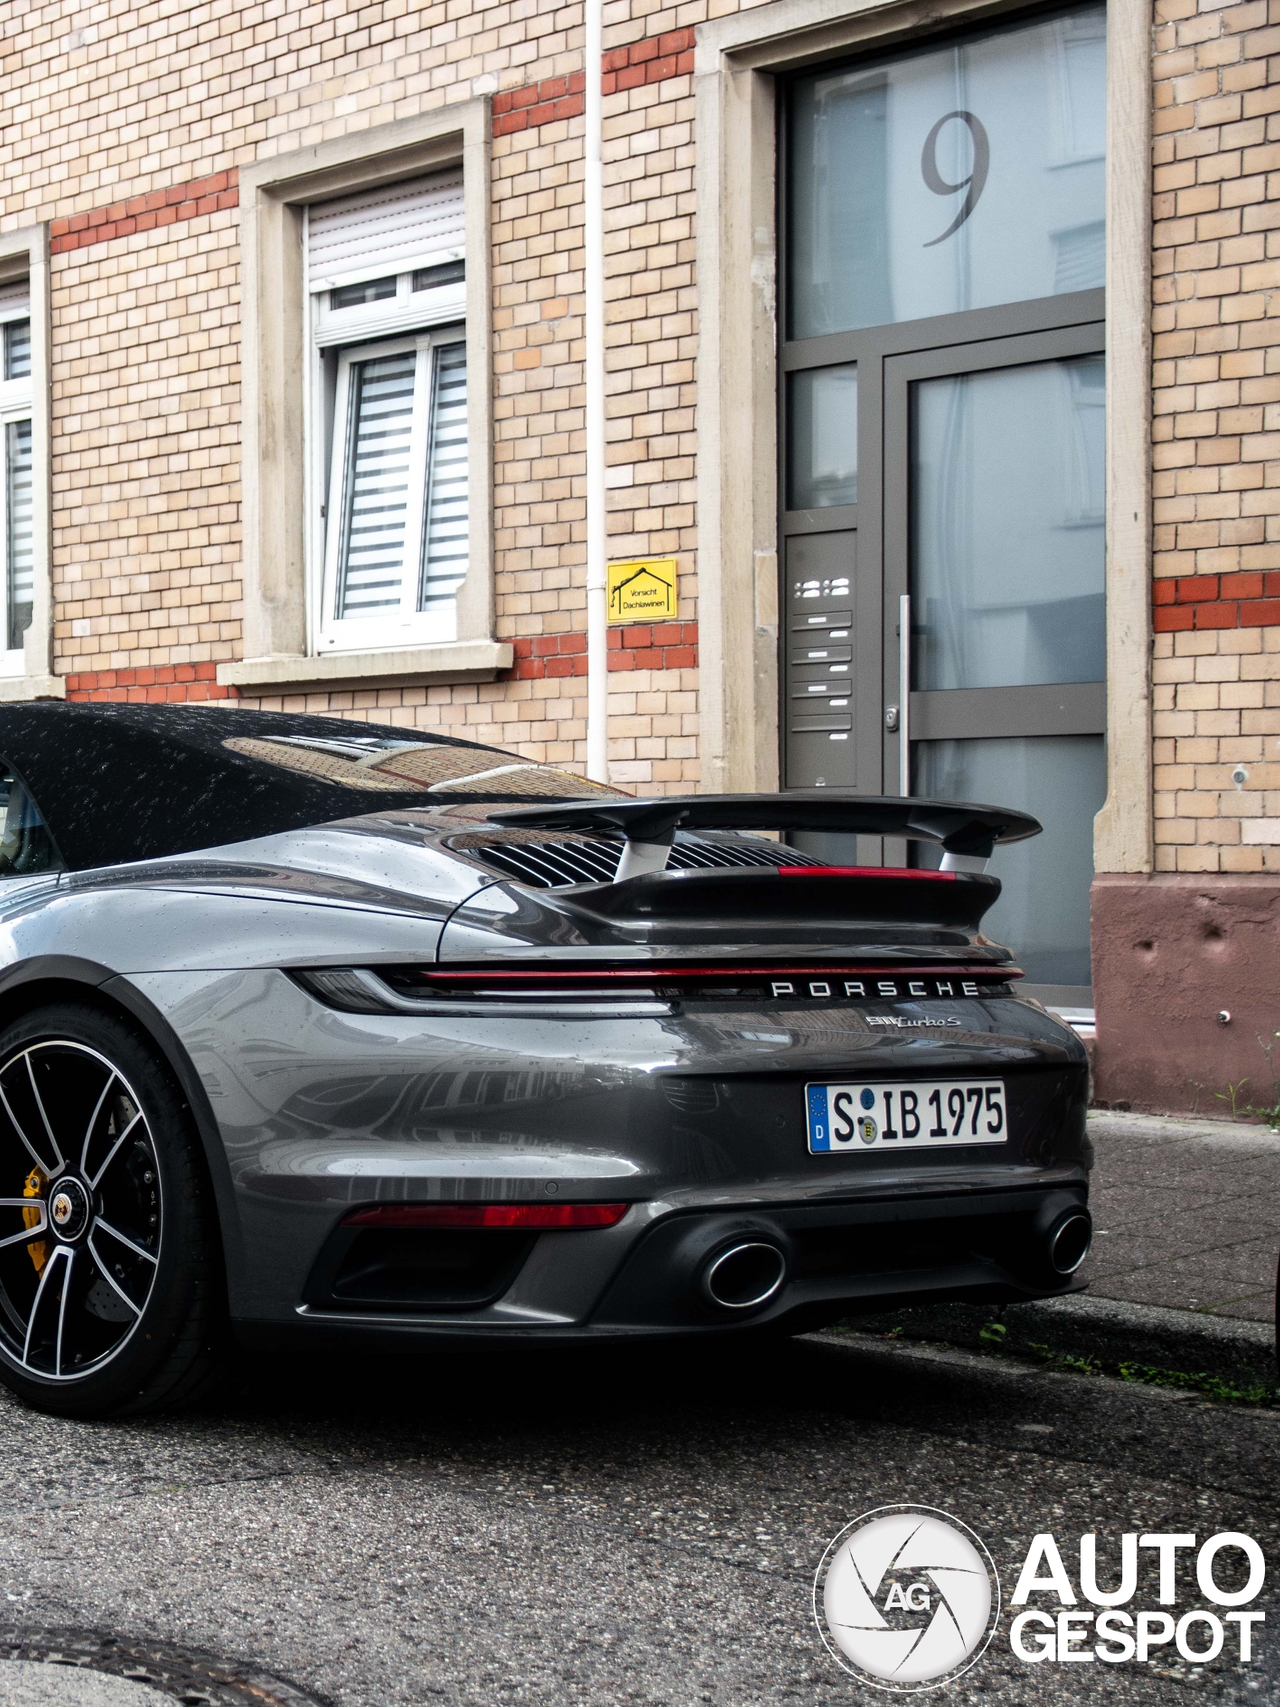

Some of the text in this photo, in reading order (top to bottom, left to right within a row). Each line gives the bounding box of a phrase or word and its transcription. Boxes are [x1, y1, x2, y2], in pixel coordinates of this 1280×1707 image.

[921, 110, 990, 248] 9
[630, 588, 657, 597] Vorsicht
[623, 600, 665, 609] Dachlawinen
[771, 981, 979, 997] PORSCHE
[946, 1016, 961, 1027] S
[833, 1092, 855, 1142] S
[928, 1086, 1003, 1137] 1975
[815, 1125, 824, 1139] D
